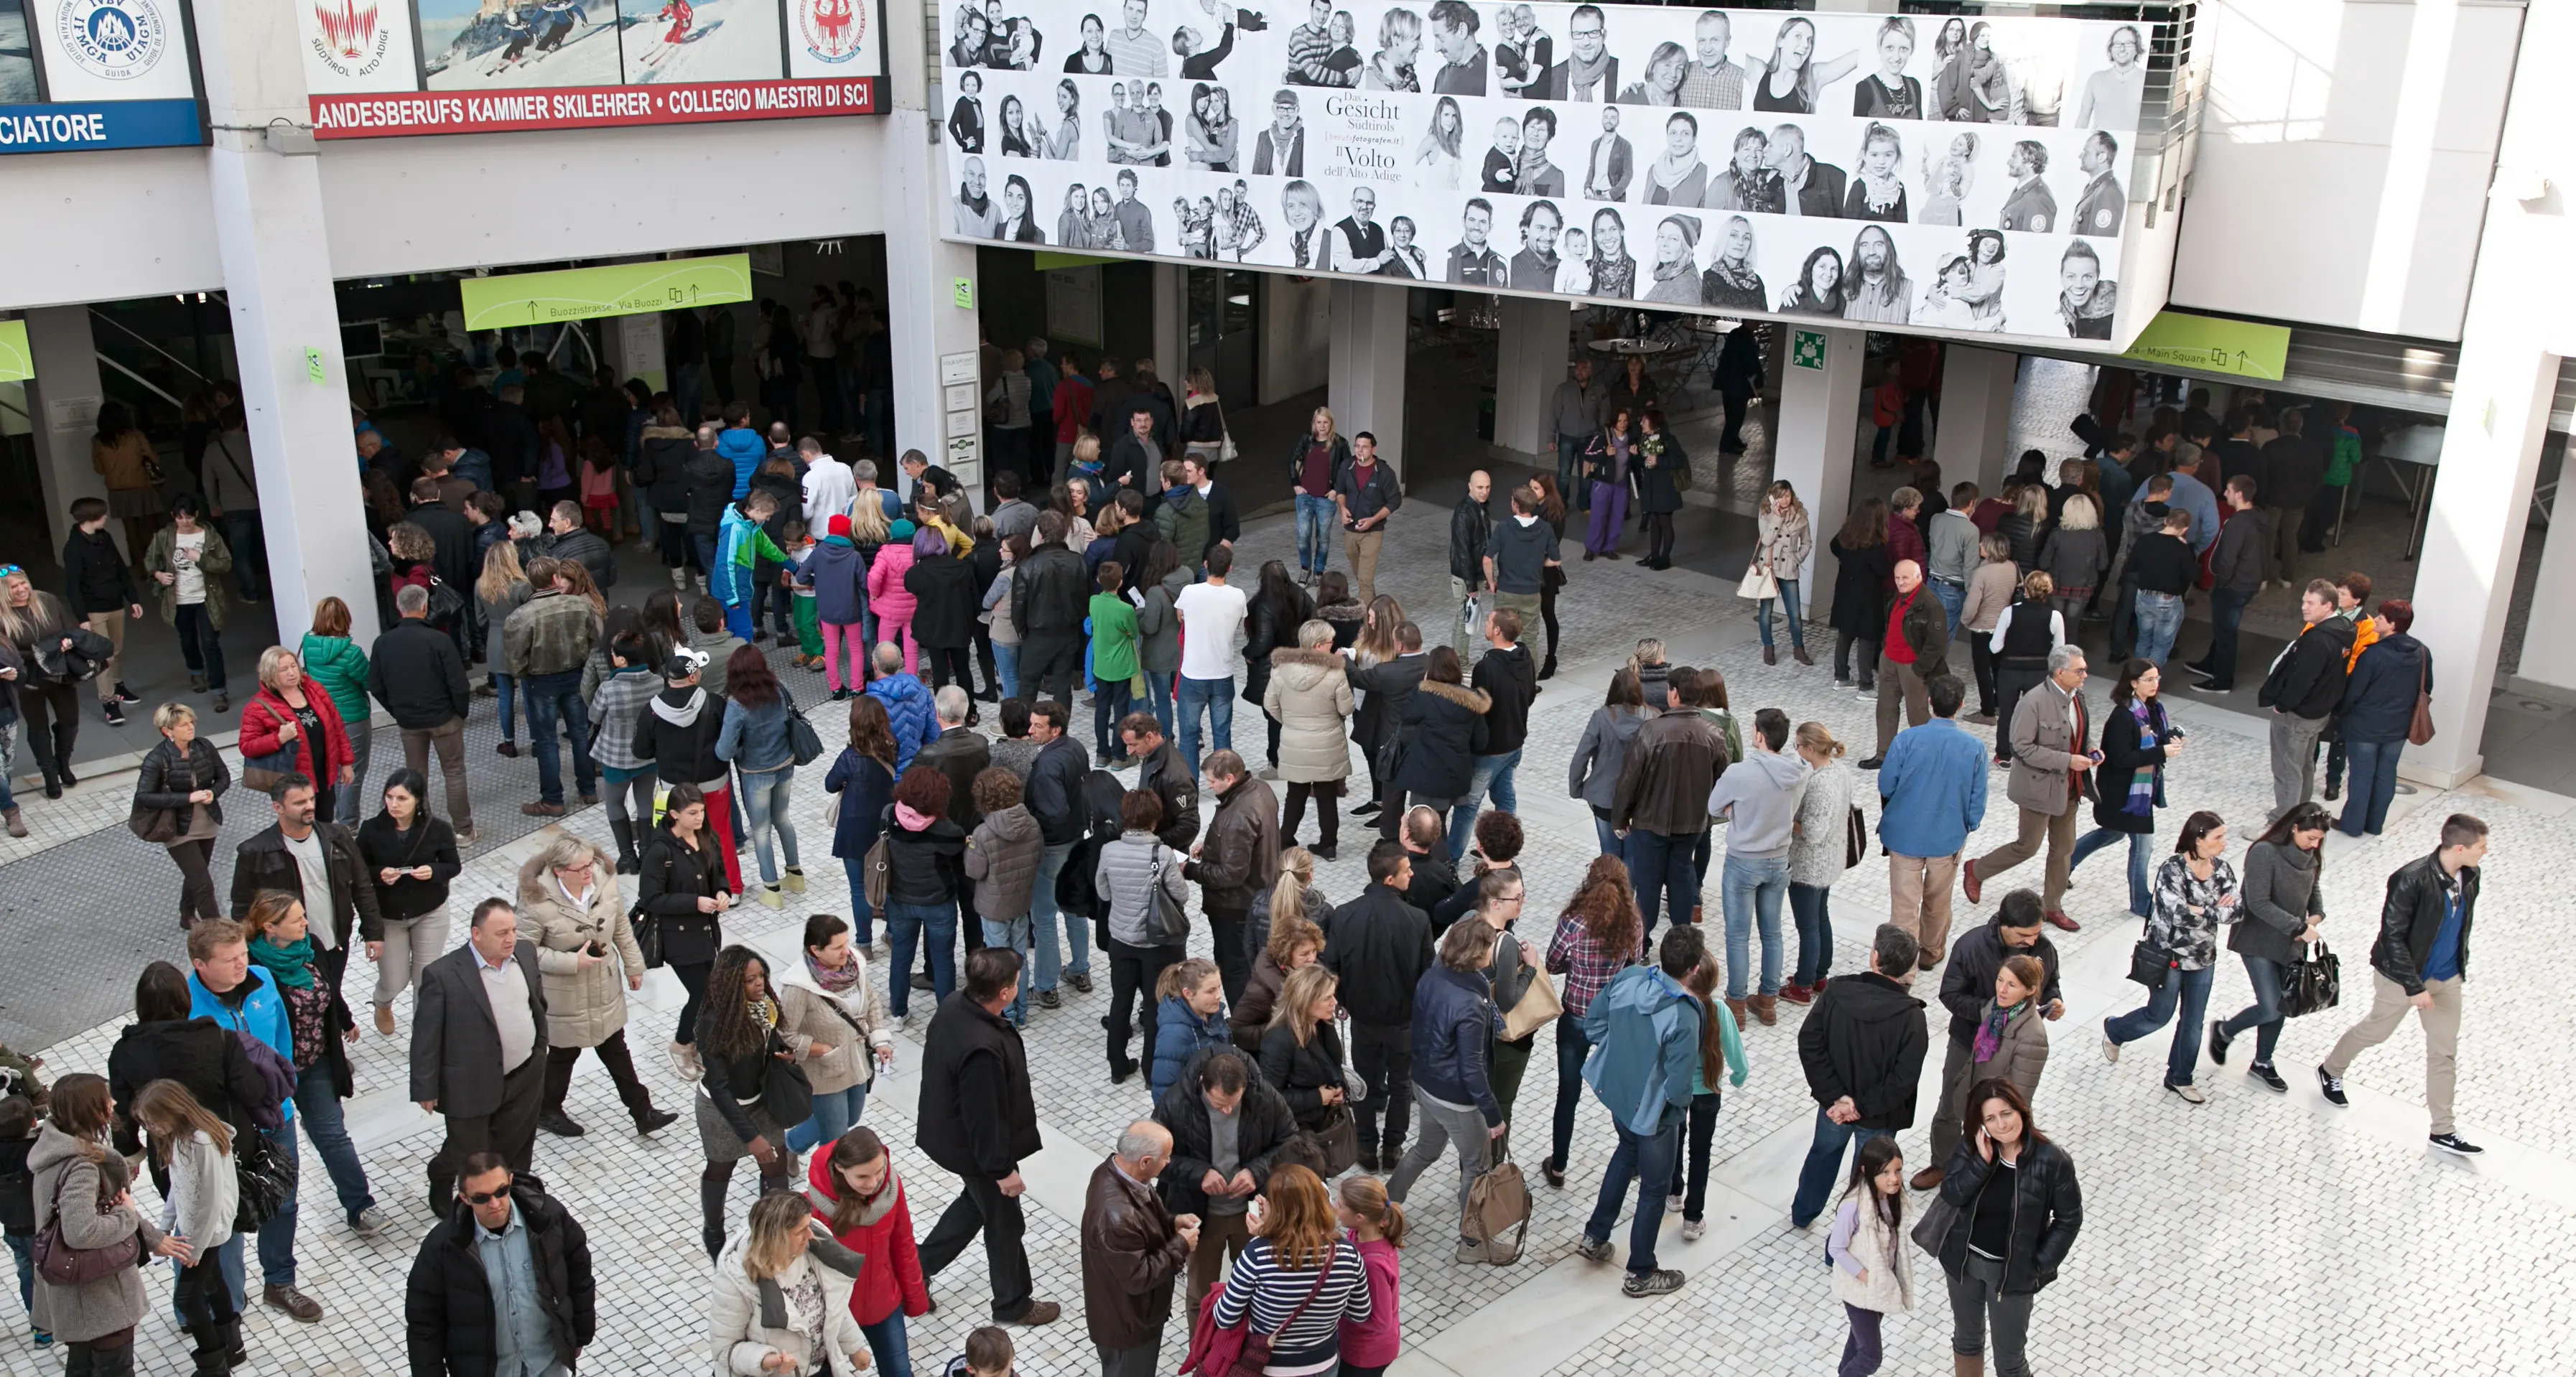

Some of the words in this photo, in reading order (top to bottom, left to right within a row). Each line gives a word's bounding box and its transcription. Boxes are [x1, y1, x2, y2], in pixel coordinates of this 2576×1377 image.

[60, 1, 73, 39] MOUNTAIN
[141, 0, 162, 35] MONTAGNE
[74, 17, 108, 63] IFMGA
[126, 14, 149, 61] UIAGM
[155, 37, 162, 47] DE
[66, 42, 86, 65] GUIDE
[144, 47, 159, 66] GUIDE
[312, 38, 350, 77] SÜDTIROL
[359, 59, 380, 77] ALTO
[376, 29, 389, 60] ADIGE
[314, 98, 463, 129] ANDESBERUFS
[468, 95, 549, 123] KAMMER
[553, 92, 651, 118] SKILEHRER
[669, 88, 751, 114] COLLEGIO
[755, 85, 822, 110] MAESTRI
[825, 85, 840, 106] DI
[844, 83, 868, 106] SCI
[1326, 95, 1400, 120] Gesicht
[1344, 91, 1362, 101] Das
[0, 113, 107, 144] CIATORE
[1347, 118, 1395, 132] Südtirols
[1336, 146, 1343, 157] Il
[1344, 146, 1395, 169] Volto
[1371, 169, 1402, 184] Adige
[550, 303, 612, 317] Buozzistrasse
[618, 300, 633, 310] Via
[634, 297, 662, 309] Buozzi
[2147, 347, 2170, 359] Main
[2172, 350, 2207, 365] Square
